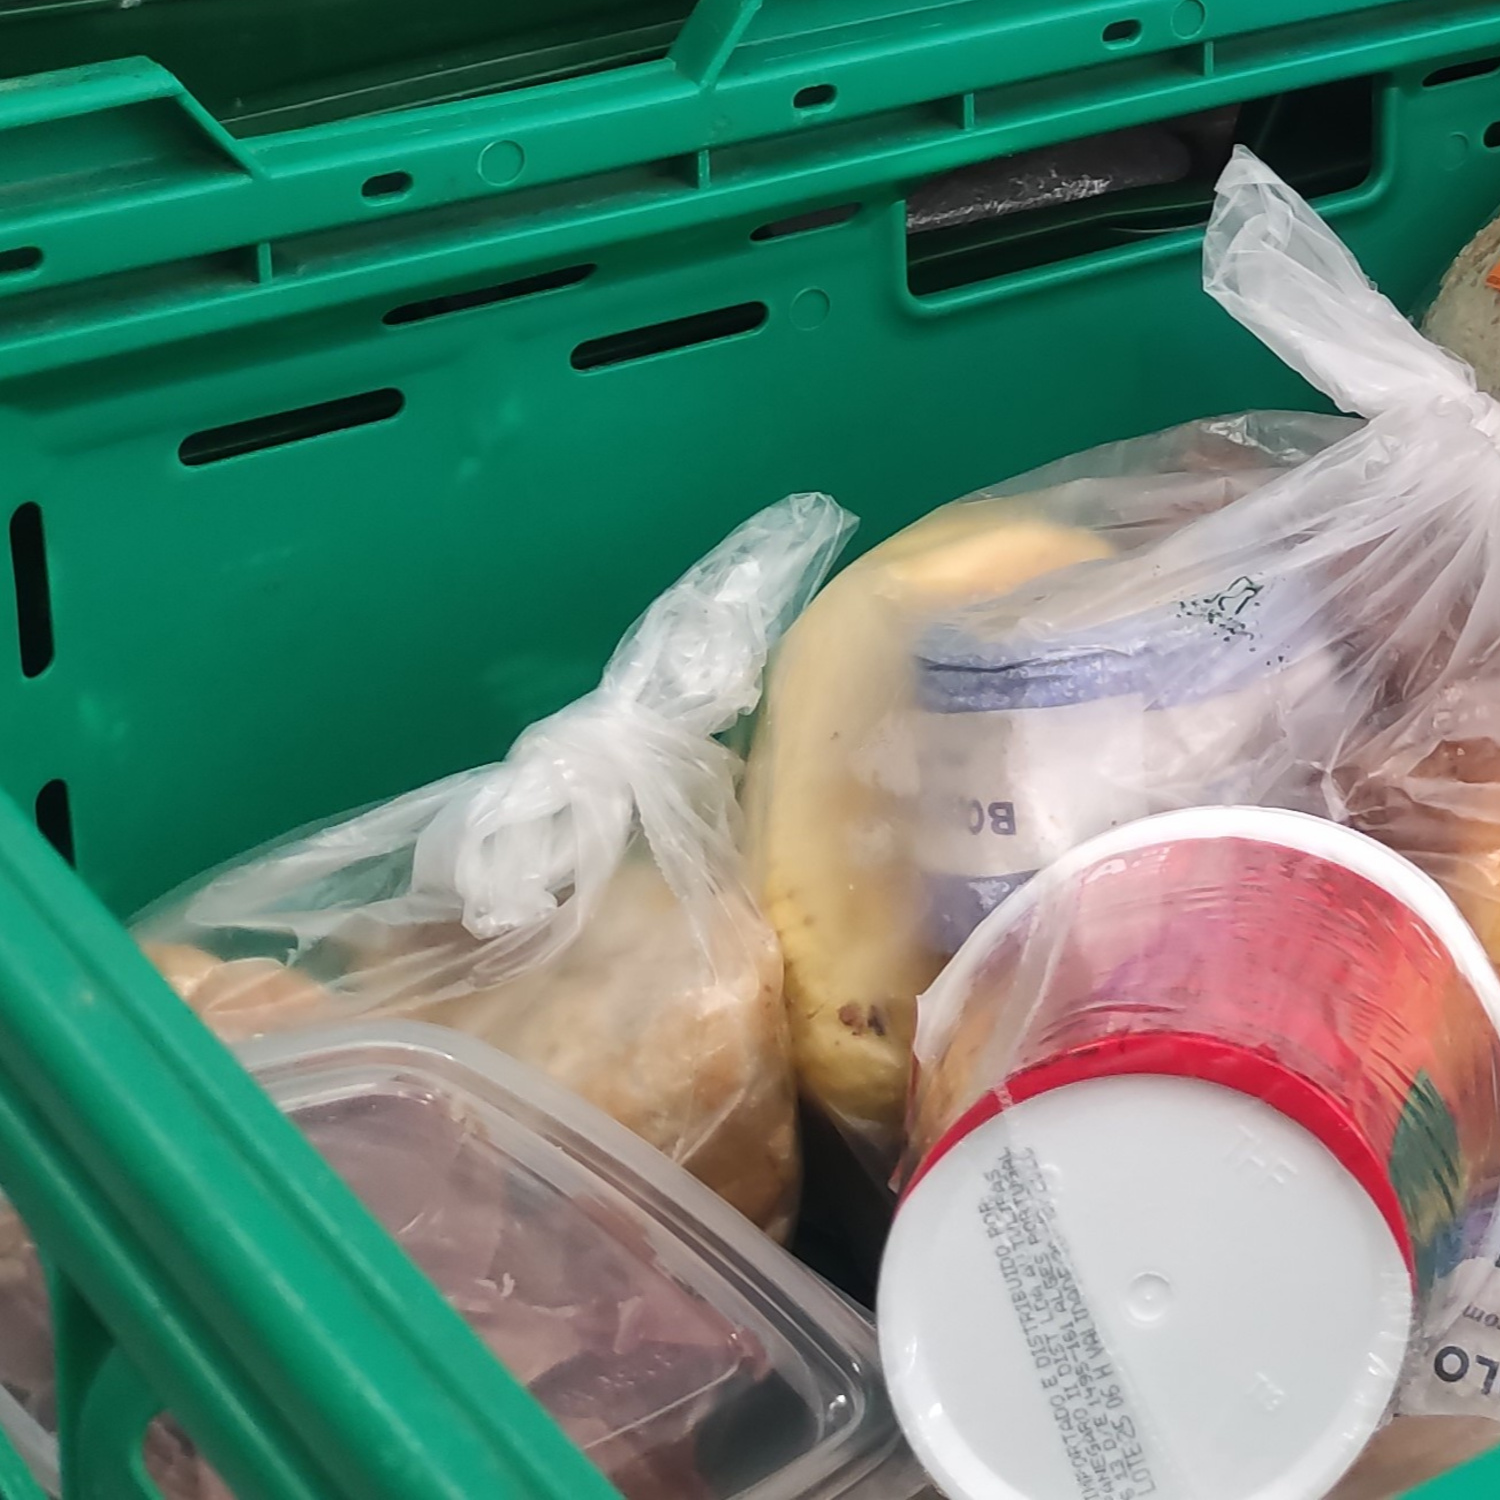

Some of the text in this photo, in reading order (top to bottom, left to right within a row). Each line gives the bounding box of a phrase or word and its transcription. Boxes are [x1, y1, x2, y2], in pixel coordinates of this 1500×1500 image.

[977, 1201, 1002, 1238] POR
[996, 1146, 1040, 1245] PORTUGAL
[993, 1243, 1051, 1368] DISTRIBUIDO
[1033, 1251, 1066, 1314] ALGES
[1045, 1330, 1072, 1376] DIST
[1059, 1321, 1101, 1407] 1495-161
[1091, 1362, 1114, 1379] H
[1040, 1374, 1058, 1388] E
[1099, 1383, 1125, 1409] 06
[1048, 1392, 1099, 1500] IMPORTADO
[1072, 1406, 1115, 1500] ANEGARO
[1092, 1413, 1117, 1451] D/E
[1108, 1458, 1127, 1481] 13
[1121, 1442, 1155, 1495] LOTE
